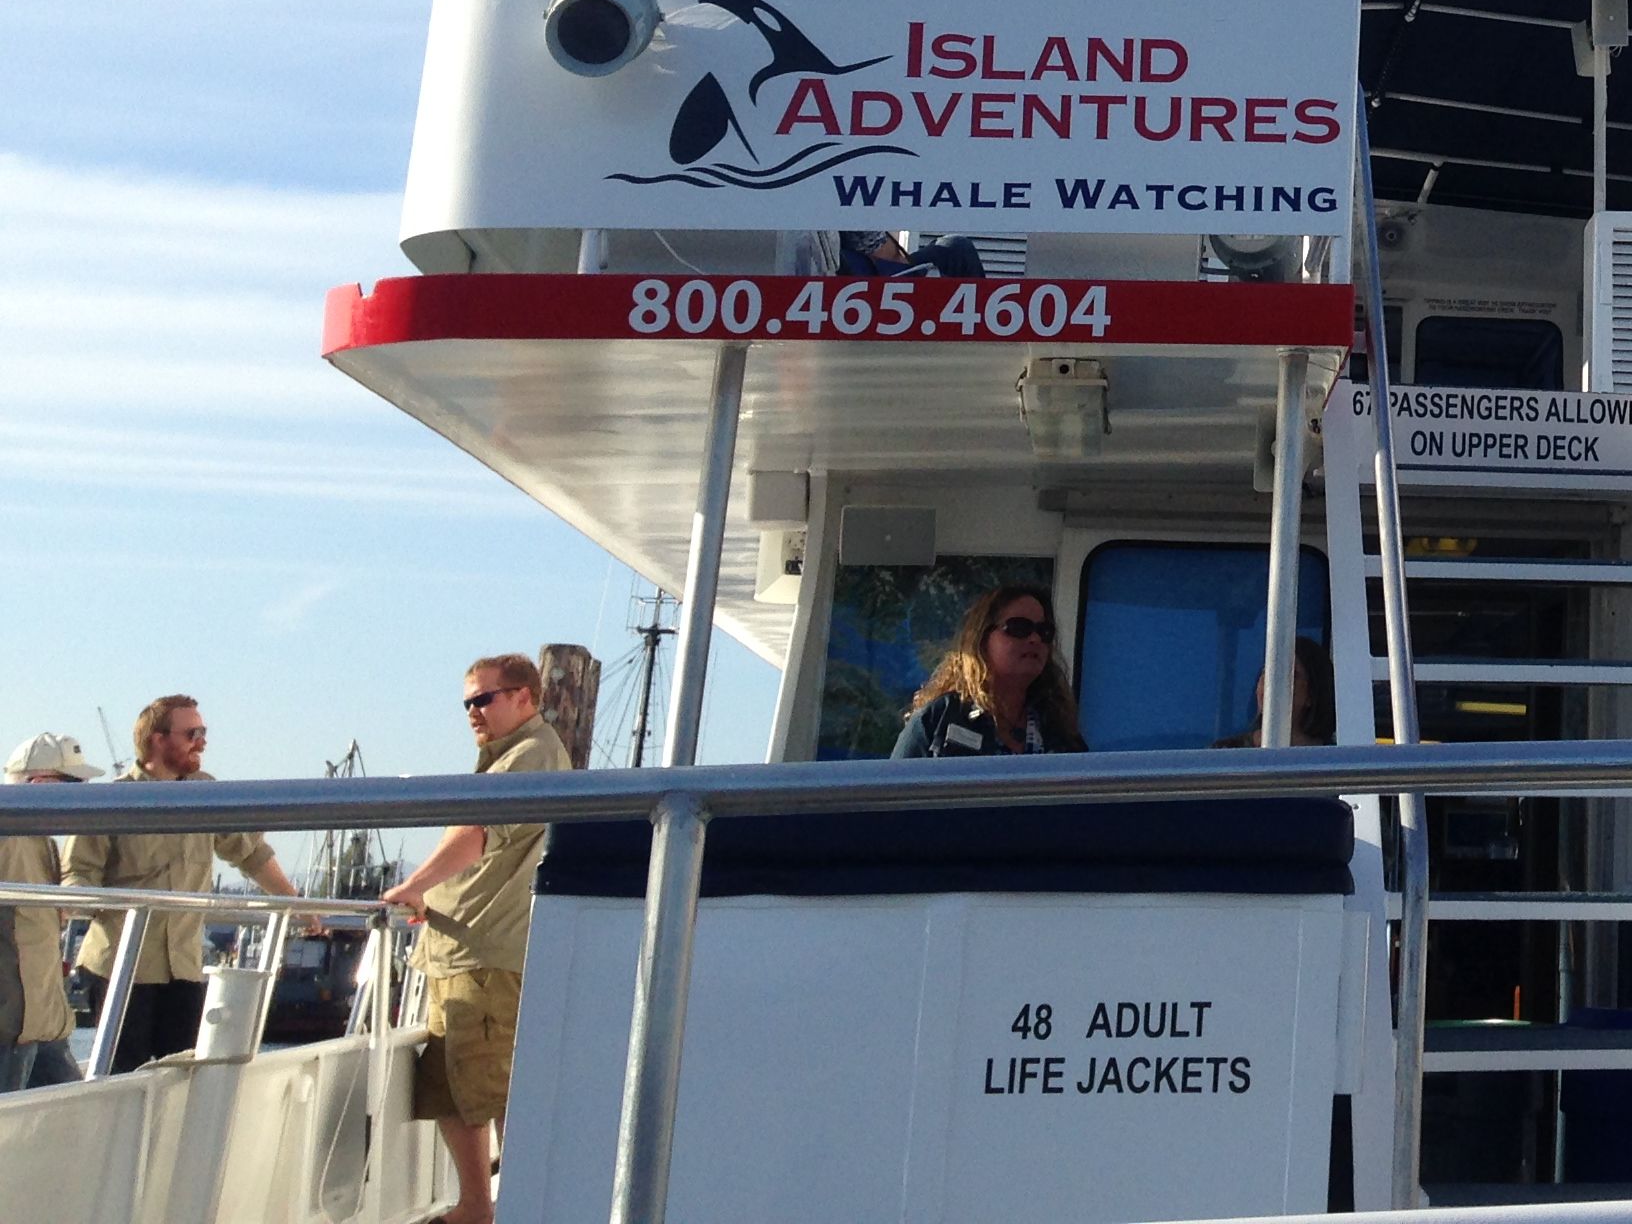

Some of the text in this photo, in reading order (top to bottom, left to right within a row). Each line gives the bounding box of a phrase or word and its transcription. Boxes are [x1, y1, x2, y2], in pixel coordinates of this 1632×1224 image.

[908, 22, 1188, 83] ISLAND
[776, 78, 1341, 143] ADVENTURES
[832, 175, 1338, 213] WHALE WATCHING
[628, 278, 1111, 338] 800.465.4604
[1389, 391, 1540, 422] PASSENGERS
[1410, 430, 1600, 462] ON UPPER DECK
[1011, 1001, 1213, 1041] 48 ADULT
[984, 1056, 1252, 1095] LIFE JACKETS
